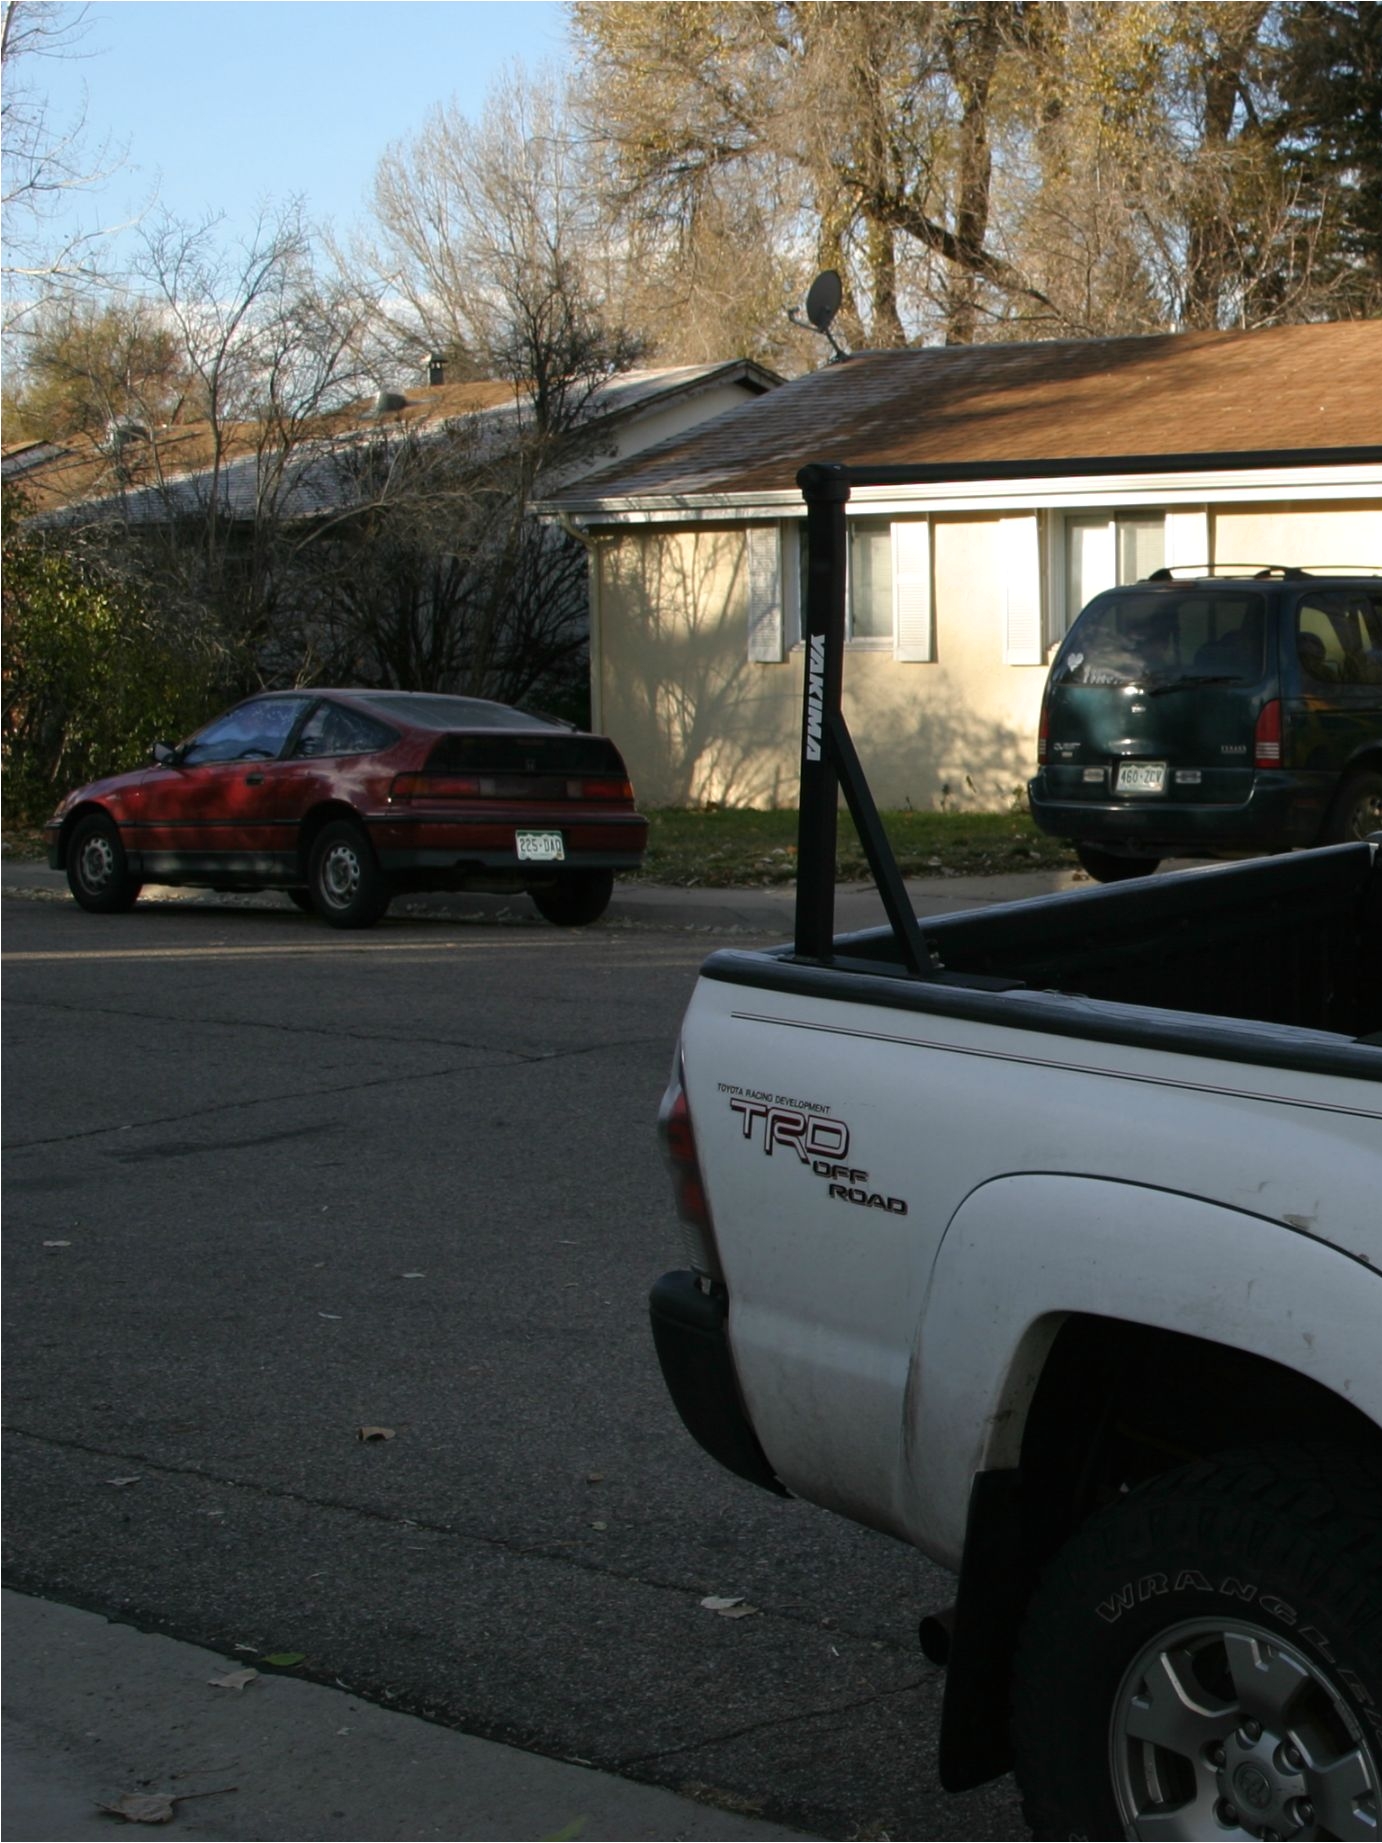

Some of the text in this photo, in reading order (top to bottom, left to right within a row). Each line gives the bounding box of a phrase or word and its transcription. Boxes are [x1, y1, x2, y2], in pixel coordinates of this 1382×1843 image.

[806, 634, 825, 761] YAKIMA
[717, 1082, 831, 1114] TOYOTA RACING DEVELOPMENT
[730, 1097, 850, 1164] TRD
[812, 1160, 868, 1184] OFF
[828, 1183, 908, 1216] ROAD
